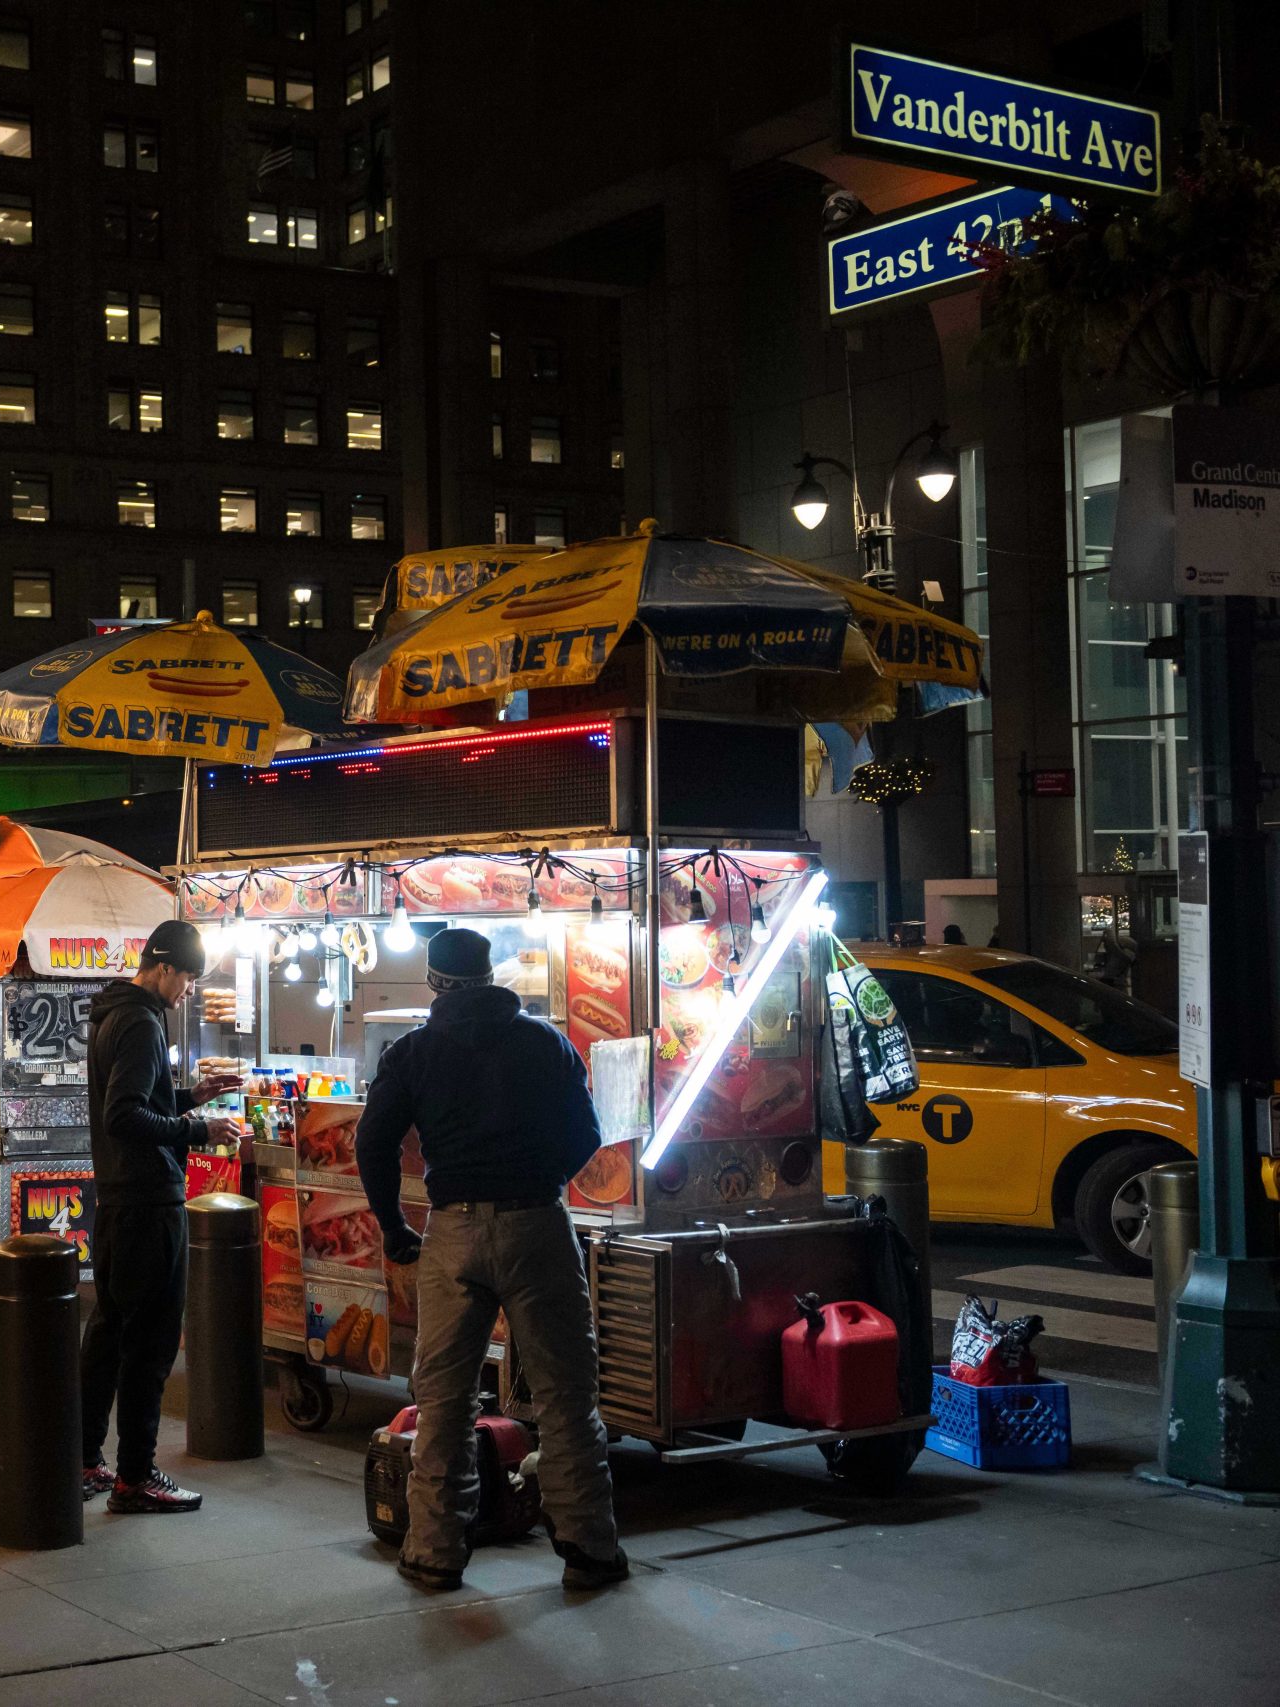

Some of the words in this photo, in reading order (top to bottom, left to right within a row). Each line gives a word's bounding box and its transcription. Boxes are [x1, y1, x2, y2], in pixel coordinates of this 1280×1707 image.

[858, 69, 1071, 161] Vanderbilt
[1082, 120, 1153, 177] Ave
[843, 238, 934, 294] East
[1191, 460, 1242, 481] Grand
[1193, 487, 1266, 511] Madison
[467, 561, 634, 614] SABRETT
[717, 633, 741, 650] ON
[746, 635, 757, 646] A
[762, 628, 806, 646] ROLL
[812, 626, 832, 643] !!!
[109, 658, 245, 675] SABRETT
[402, 621, 618, 697] SABRETT
[64, 701, 270, 752] SABRETT
[36, 983, 74, 994] CORDILLERA
[427, 971, 454, 988] NEW
[877, 1025, 900, 1039] SAVE
[877, 1031, 905, 1047] EARTH
[24, 1063, 62, 1074] CORDILLERA
[897, 1103, 920, 1113] NYC
[933, 1104, 961, 1138] T
[196, 1157, 212, 1172] Dog
[27, 1185, 83, 1220] NUTS
[48, 1206, 71, 1238] 4
[307, 1282, 328, 1295] Corn
[331, 1287, 353, 1299] Dog
[309, 1314, 324, 1328] NY
